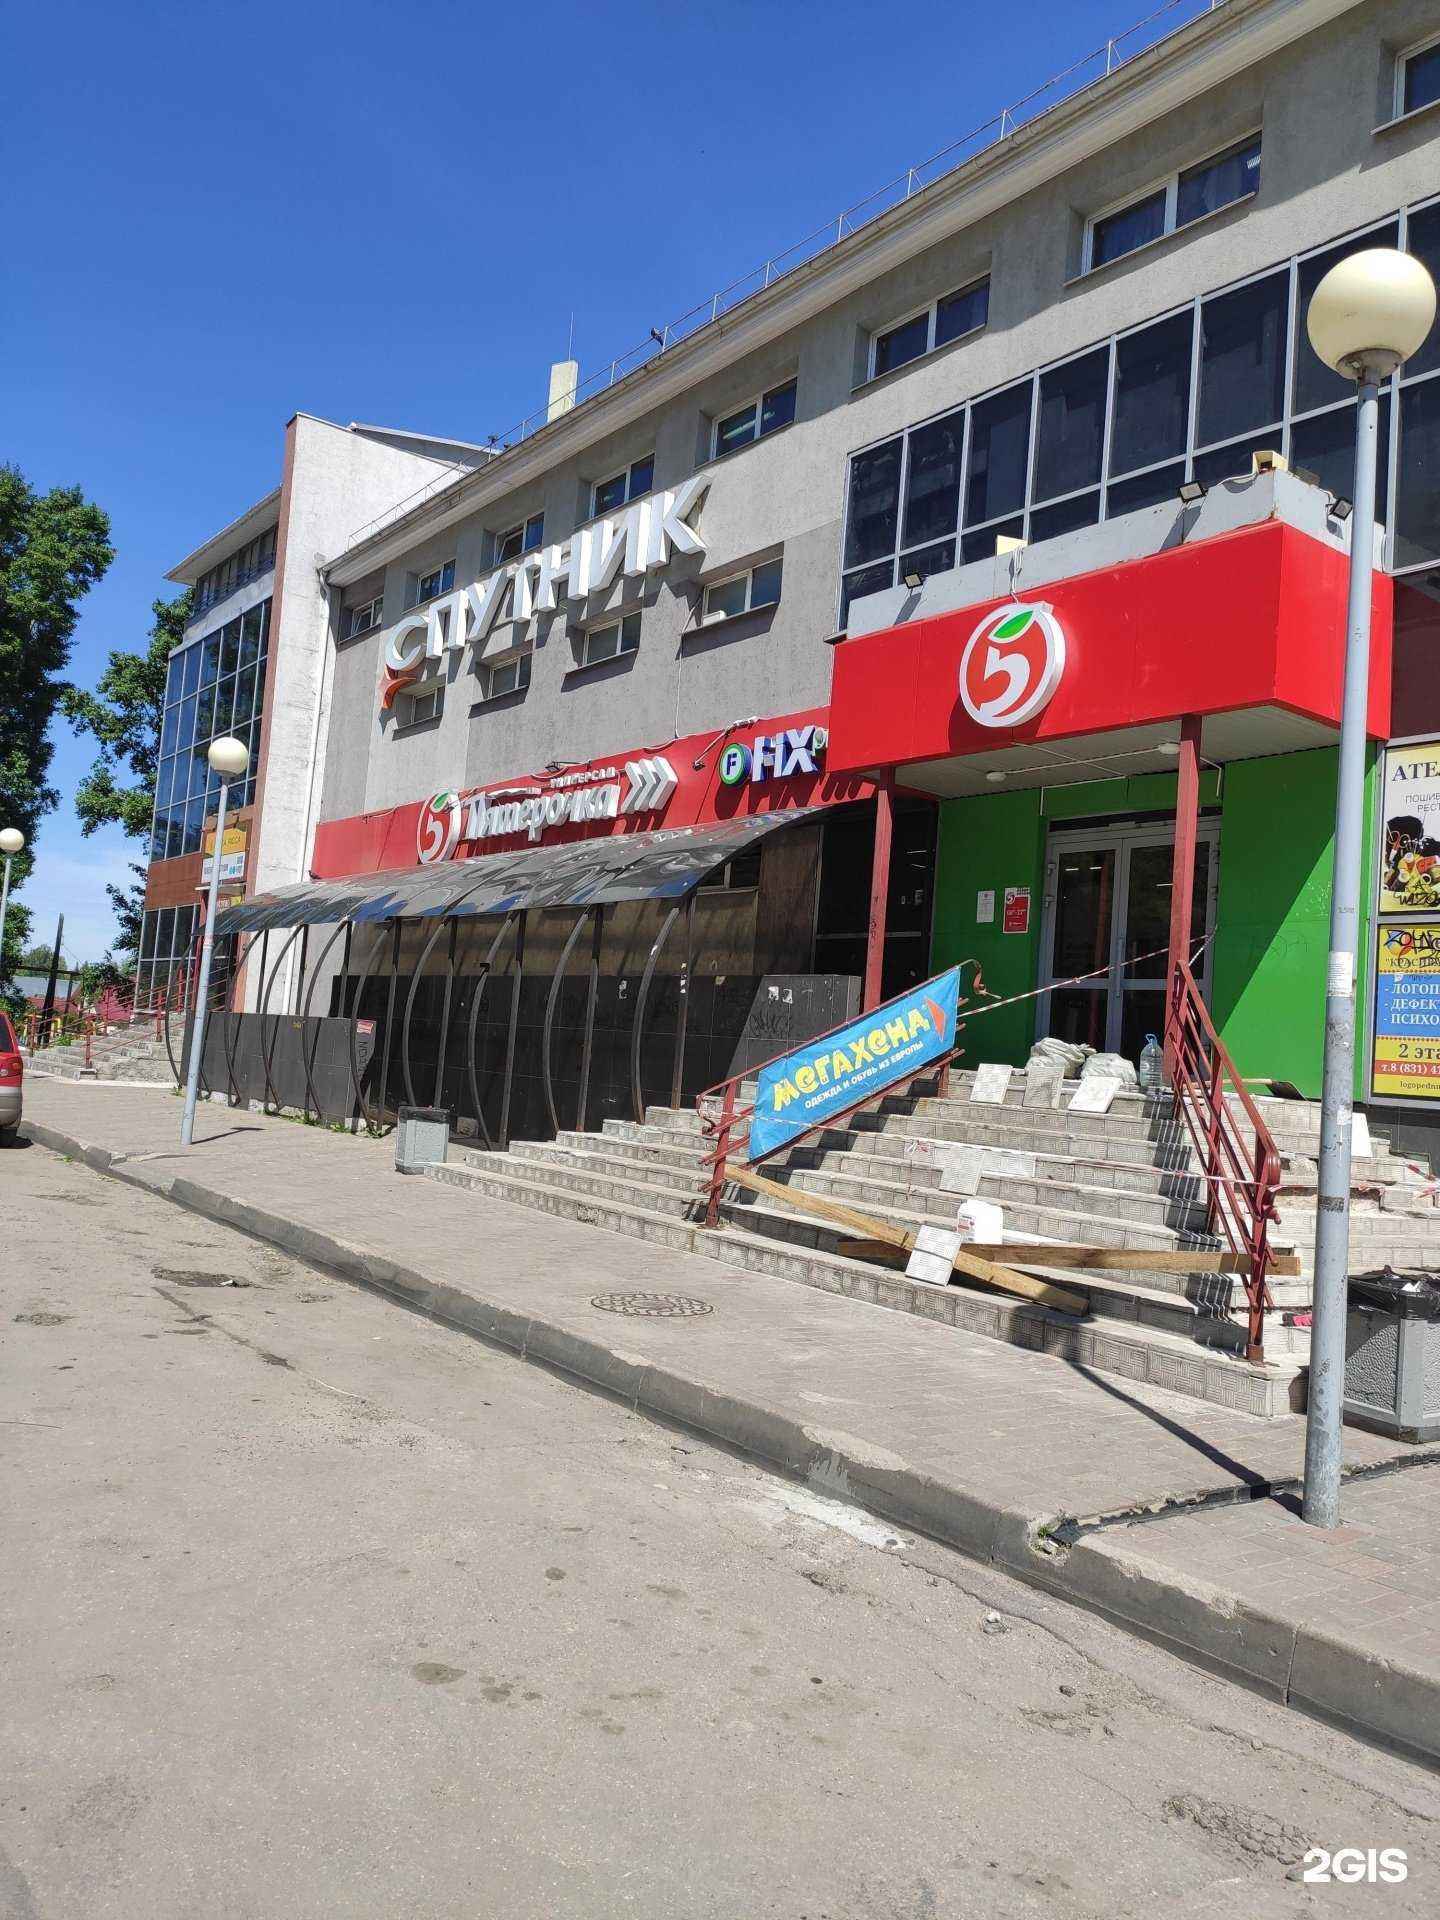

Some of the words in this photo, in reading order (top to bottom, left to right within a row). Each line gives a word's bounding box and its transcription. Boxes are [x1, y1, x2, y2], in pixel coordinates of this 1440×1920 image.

[384, 474, 714, 672] СПУТНИК
[1392, 761, 1440, 782] АТЕ
[1398, 1043, 1409, 1059] 2
[804, 1084, 842, 1110] ОДЕЖДА
[843, 1079, 851, 1091] И
[851, 1066, 878, 1085] ОБУВЬ
[878, 1059, 890, 1071] ИЗ
[890, 1041, 925, 1064] ЕВРОПЫ
[1400, 1062, 1428, 1075] (831)
